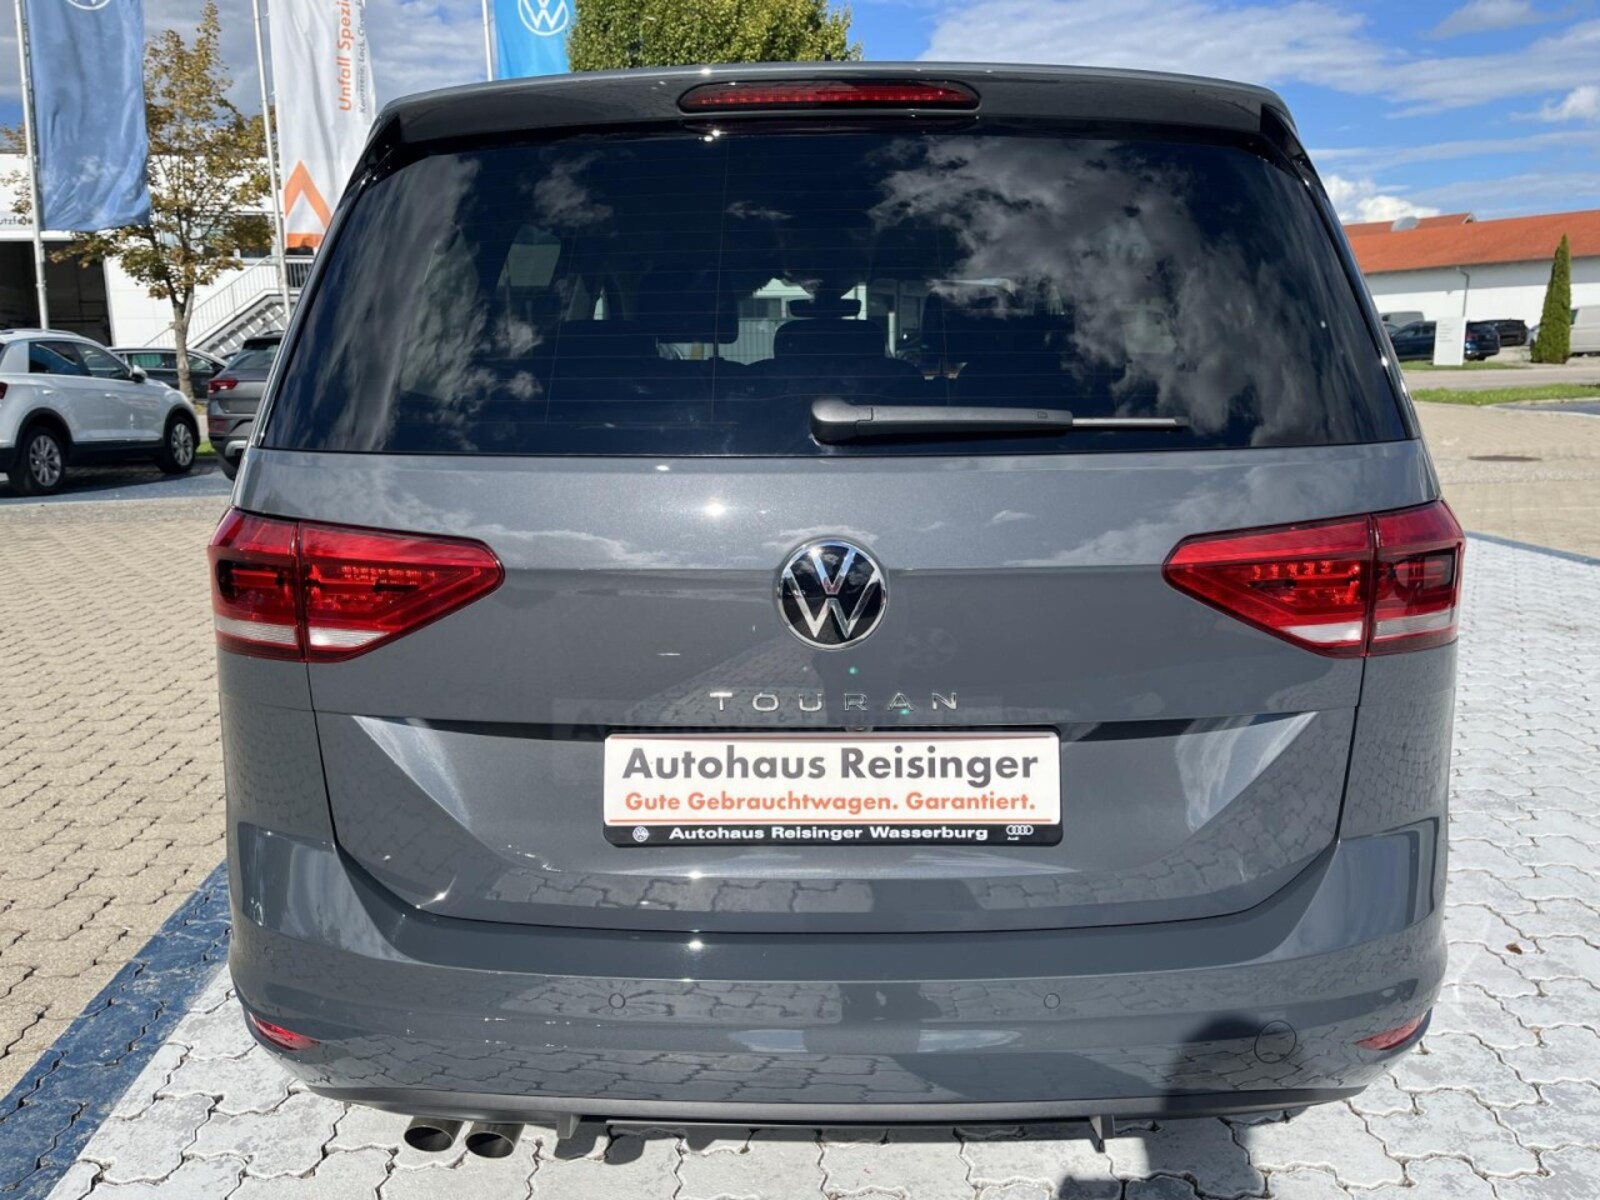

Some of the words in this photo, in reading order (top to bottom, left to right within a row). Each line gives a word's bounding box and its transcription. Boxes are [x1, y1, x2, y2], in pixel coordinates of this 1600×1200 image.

[336, 0, 354, 50] Spezi
[336, 56, 352, 111] Unfall
[709, 692, 957, 711] TOURAN
[622, 745, 826, 779] Autohaus
[841, 745, 1038, 788] Reisinger
[625, 792, 680, 811] Gute
[687, 790, 898, 815] Gebrauchtwagen.
[906, 791, 1036, 811] Garantiert.
[669, 826, 765, 840] Autohaus
[771, 826, 863, 841] Reisinger
[870, 826, 988, 841] Wasserburg
